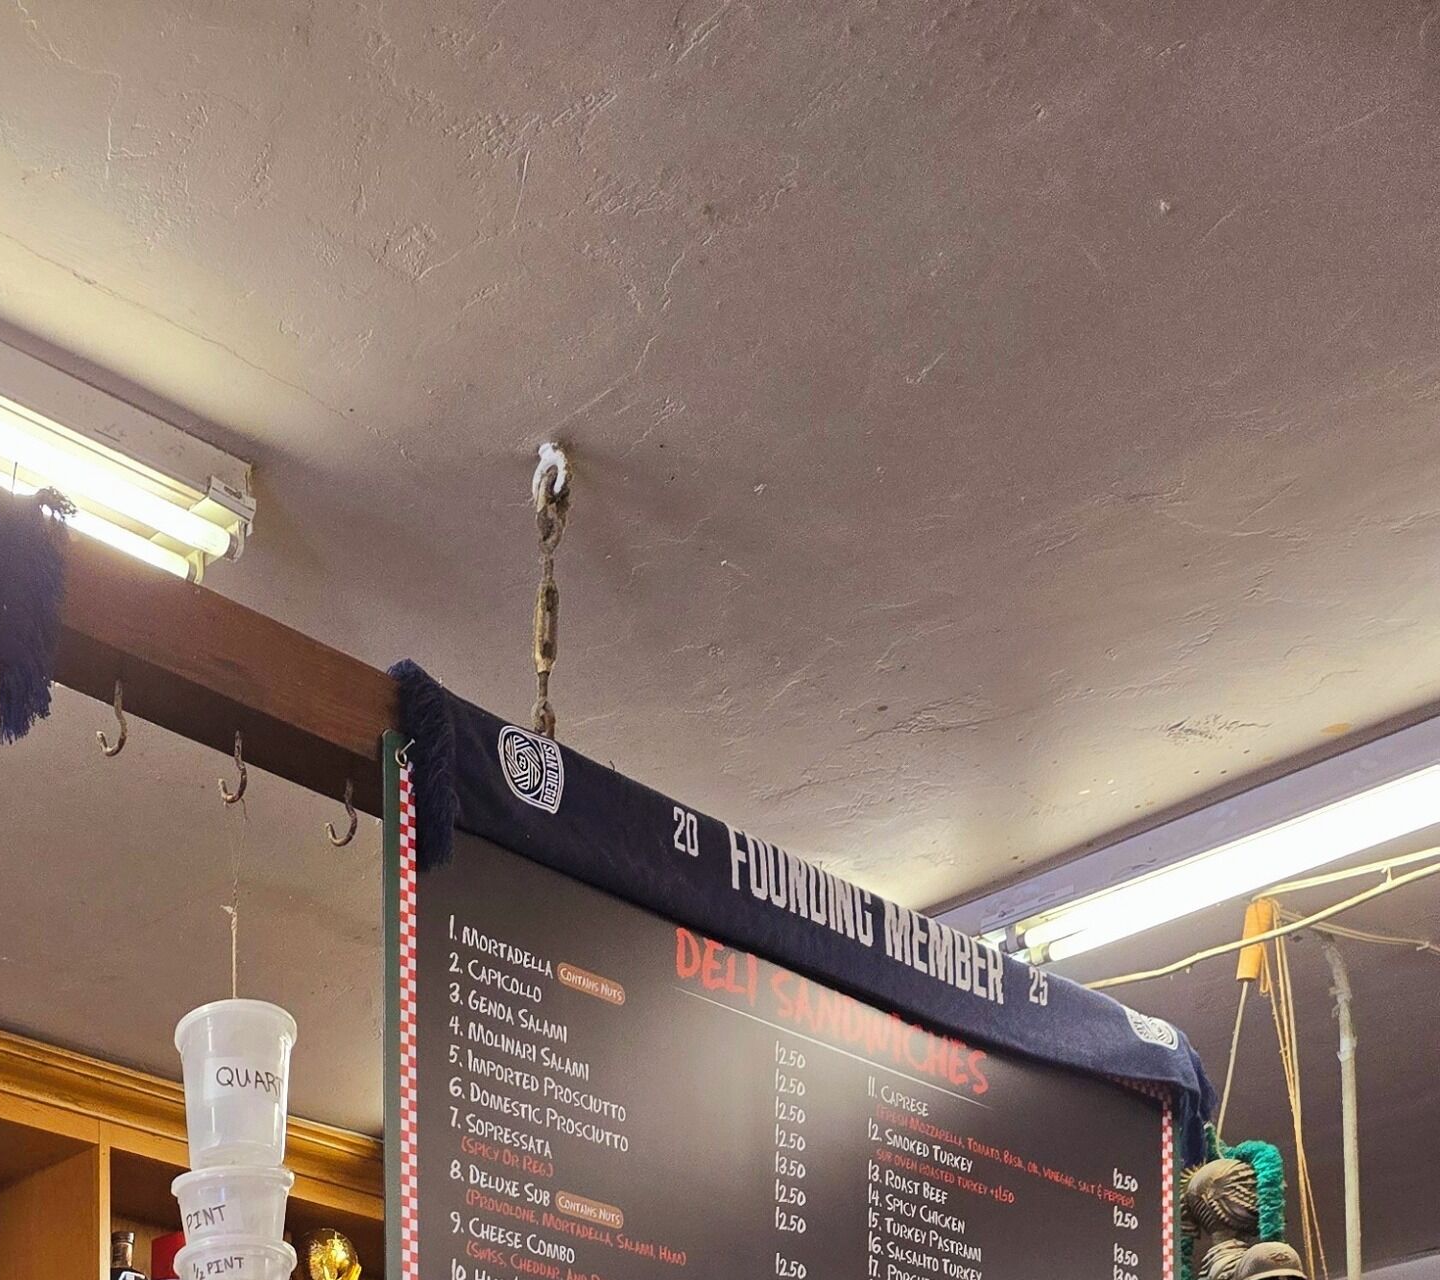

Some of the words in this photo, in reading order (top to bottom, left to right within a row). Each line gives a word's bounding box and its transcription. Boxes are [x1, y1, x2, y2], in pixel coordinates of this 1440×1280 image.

[541, 740, 558, 770] SAN
[541, 770, 560, 808] DIEGO
[673, 806, 699, 857] 20
[729, 826, 874, 947] FOUNDING
[884, 897, 1004, 1004] MEMBER
[449, 914, 458, 942] 1.
[462, 924, 554, 980] MORTADELLA
[559, 966, 600, 993] CONTAINS
[600, 984, 624, 1003] NUTS
[449, 952, 464, 975] 2.
[468, 959, 543, 1003] CAPICOLLO
[676, 927, 757, 1007] DELI
[770, 972, 990, 1095] SANDWICHES
[1028, 965, 1049, 1007] 25
[449, 984, 464, 1007] 3.
[468, 990, 514, 1024] GENOA
[518, 1008, 568, 1043] SALAMI
[449, 1016, 464, 1037] 4.
[468, 1022, 537, 1064] MOLINARI
[541, 1047, 590, 1081] SALAMI
[449, 1045, 463, 1068] 5.
[468, 1050, 540, 1092] IMPORTED
[543, 1077, 627, 1122] PROSCIUTTO
[449, 1106, 462, 1129] 7.
[465, 1114, 553, 1159] SOPRESSATA
[868, 1118, 883, 1143] 12.
[885, 1128, 929, 1159] SMOKED
[932, 1145, 974, 1174] TURKEY
[868, 1159, 883, 1185] 13.
[885, 1169, 921, 1196] ROAST
[923, 1181, 948, 1206] BEEF
[185, 1204, 227, 1232] PINT
[206, 1256, 245, 1276] PINT
